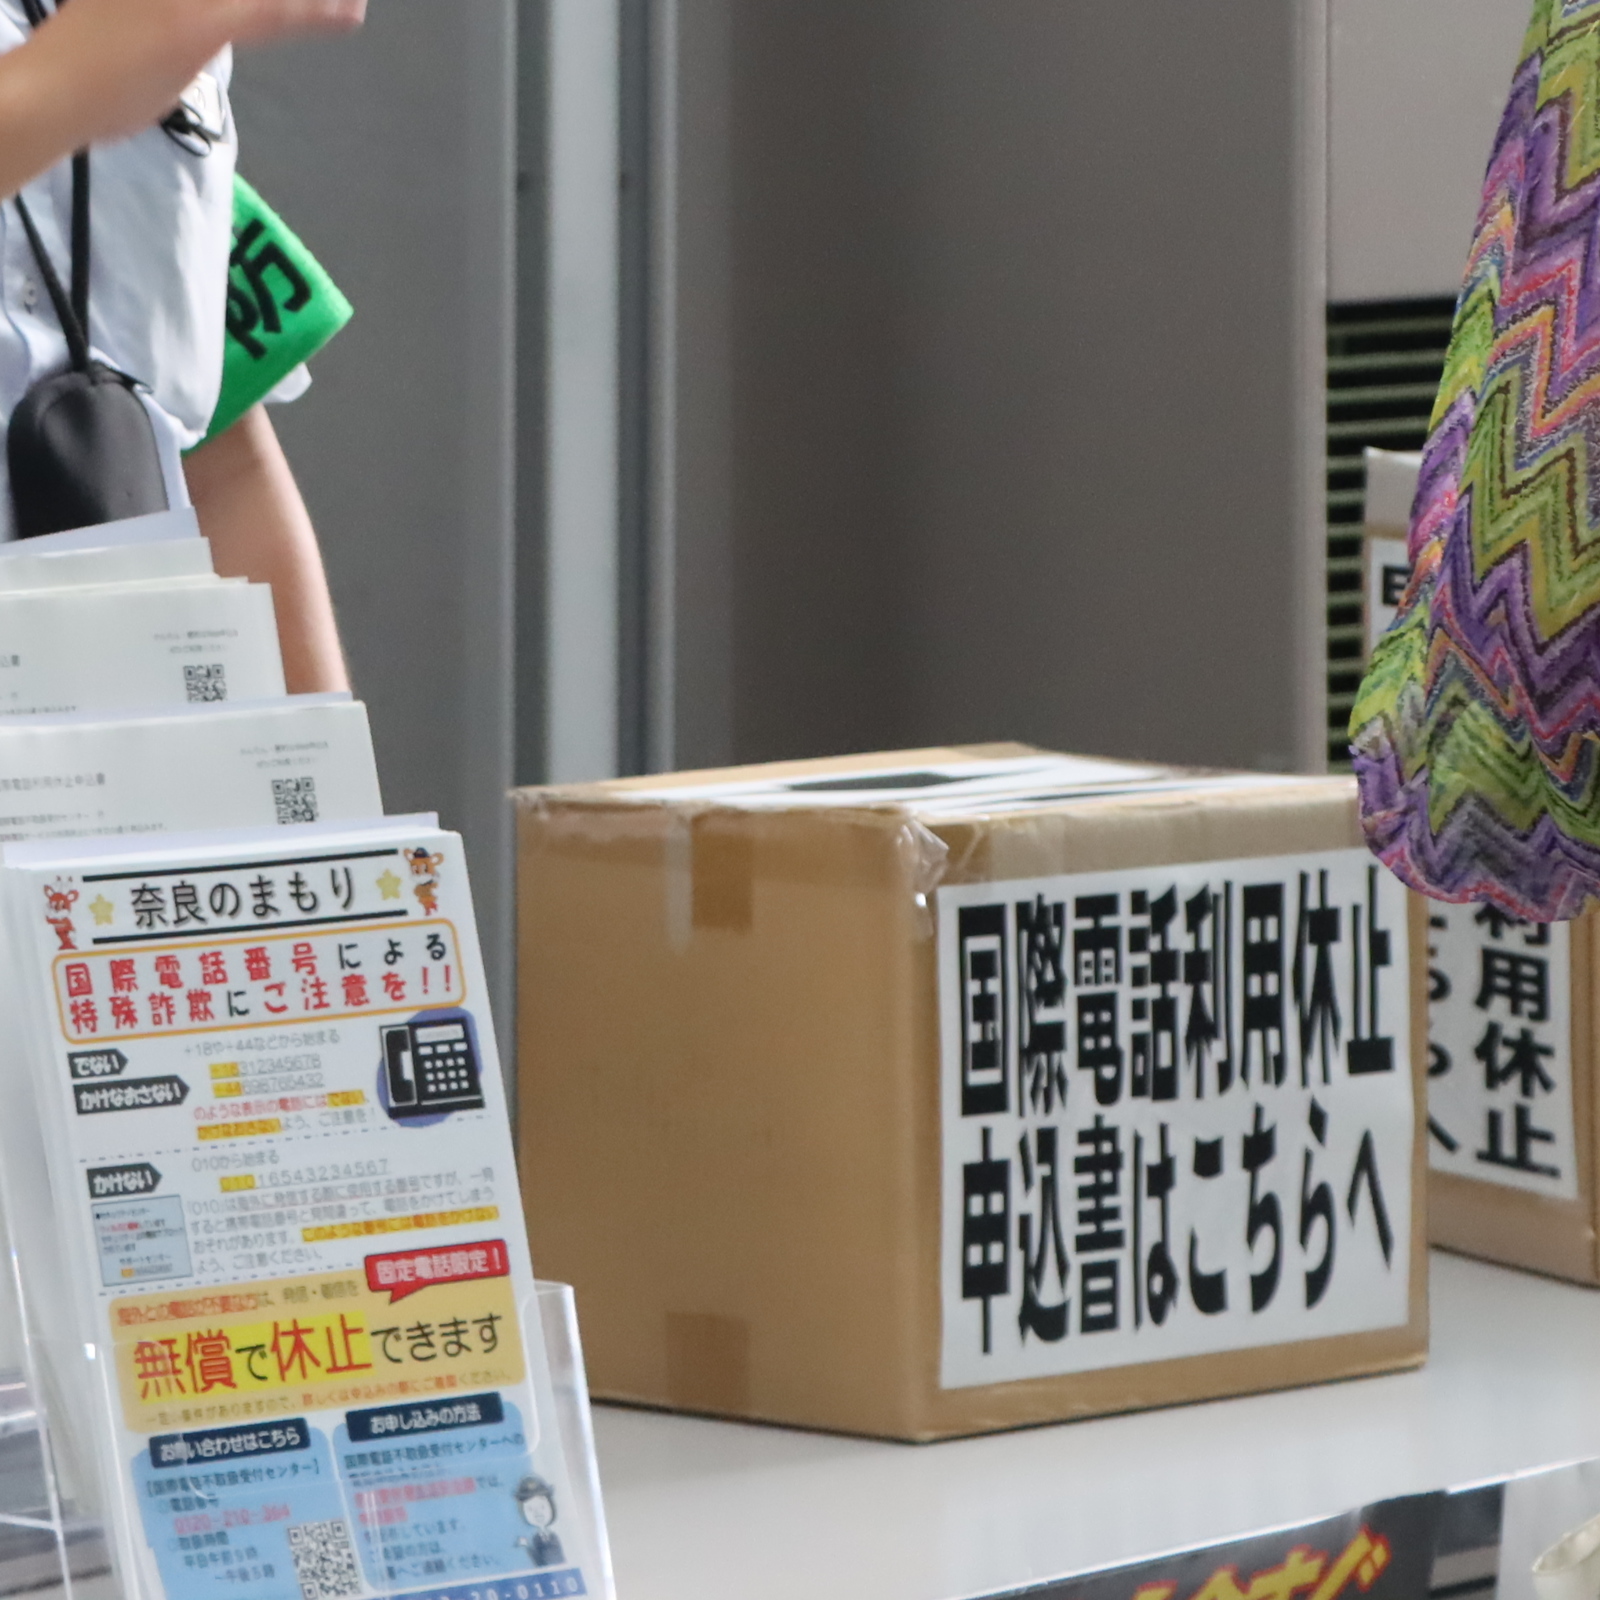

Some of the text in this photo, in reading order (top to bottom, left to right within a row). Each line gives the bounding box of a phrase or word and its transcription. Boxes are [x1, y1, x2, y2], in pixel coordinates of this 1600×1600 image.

[131, 866, 355, 929] 奈良のまもり
[64, 933, 447, 997] 国際電話番号による
[957, 865, 1395, 1119] 国際電話利用休止
[74, 1053, 119, 1076] でない
[79, 1082, 182, 1112] かけなおさない
[92, 1169, 154, 1194] かけない
[960, 1095, 1395, 1355] 申込書はこちらへ
[133, 1311, 503, 1401] 無償で休止できます
[370, 1403, 482, 1434] お申し込みの方法
[160, 1426, 301, 1462] お問い合わせはこちら
